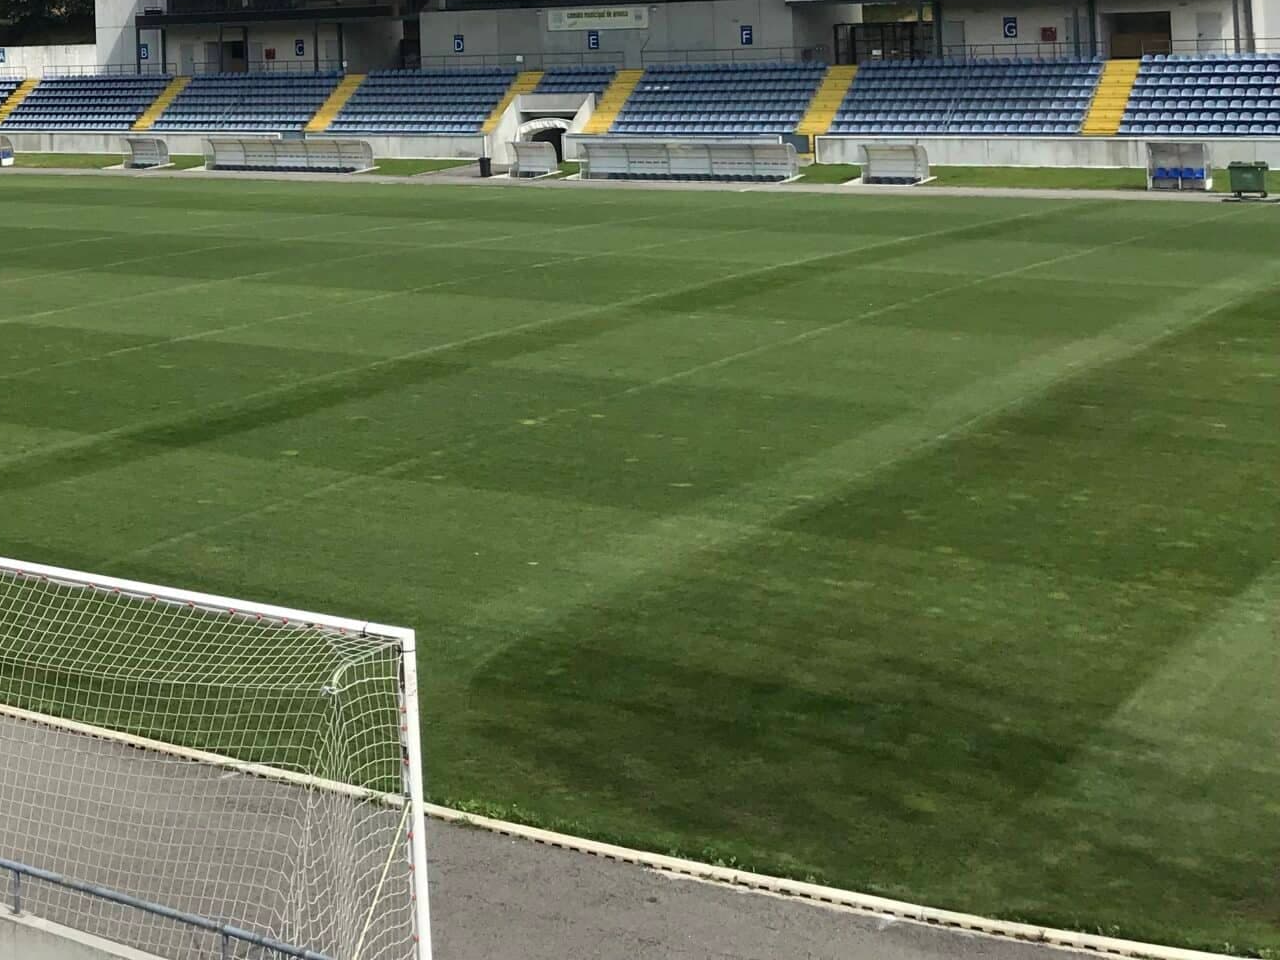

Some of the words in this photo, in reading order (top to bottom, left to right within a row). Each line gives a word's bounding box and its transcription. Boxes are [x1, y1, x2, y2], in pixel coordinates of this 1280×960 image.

[1005, 22, 1016, 36] G
[589, 36, 598, 48] E
[742, 30, 751, 44] F
[296, 43, 304, 55] C
[454, 39, 463, 51] D
[141, 47, 148, 58] B
